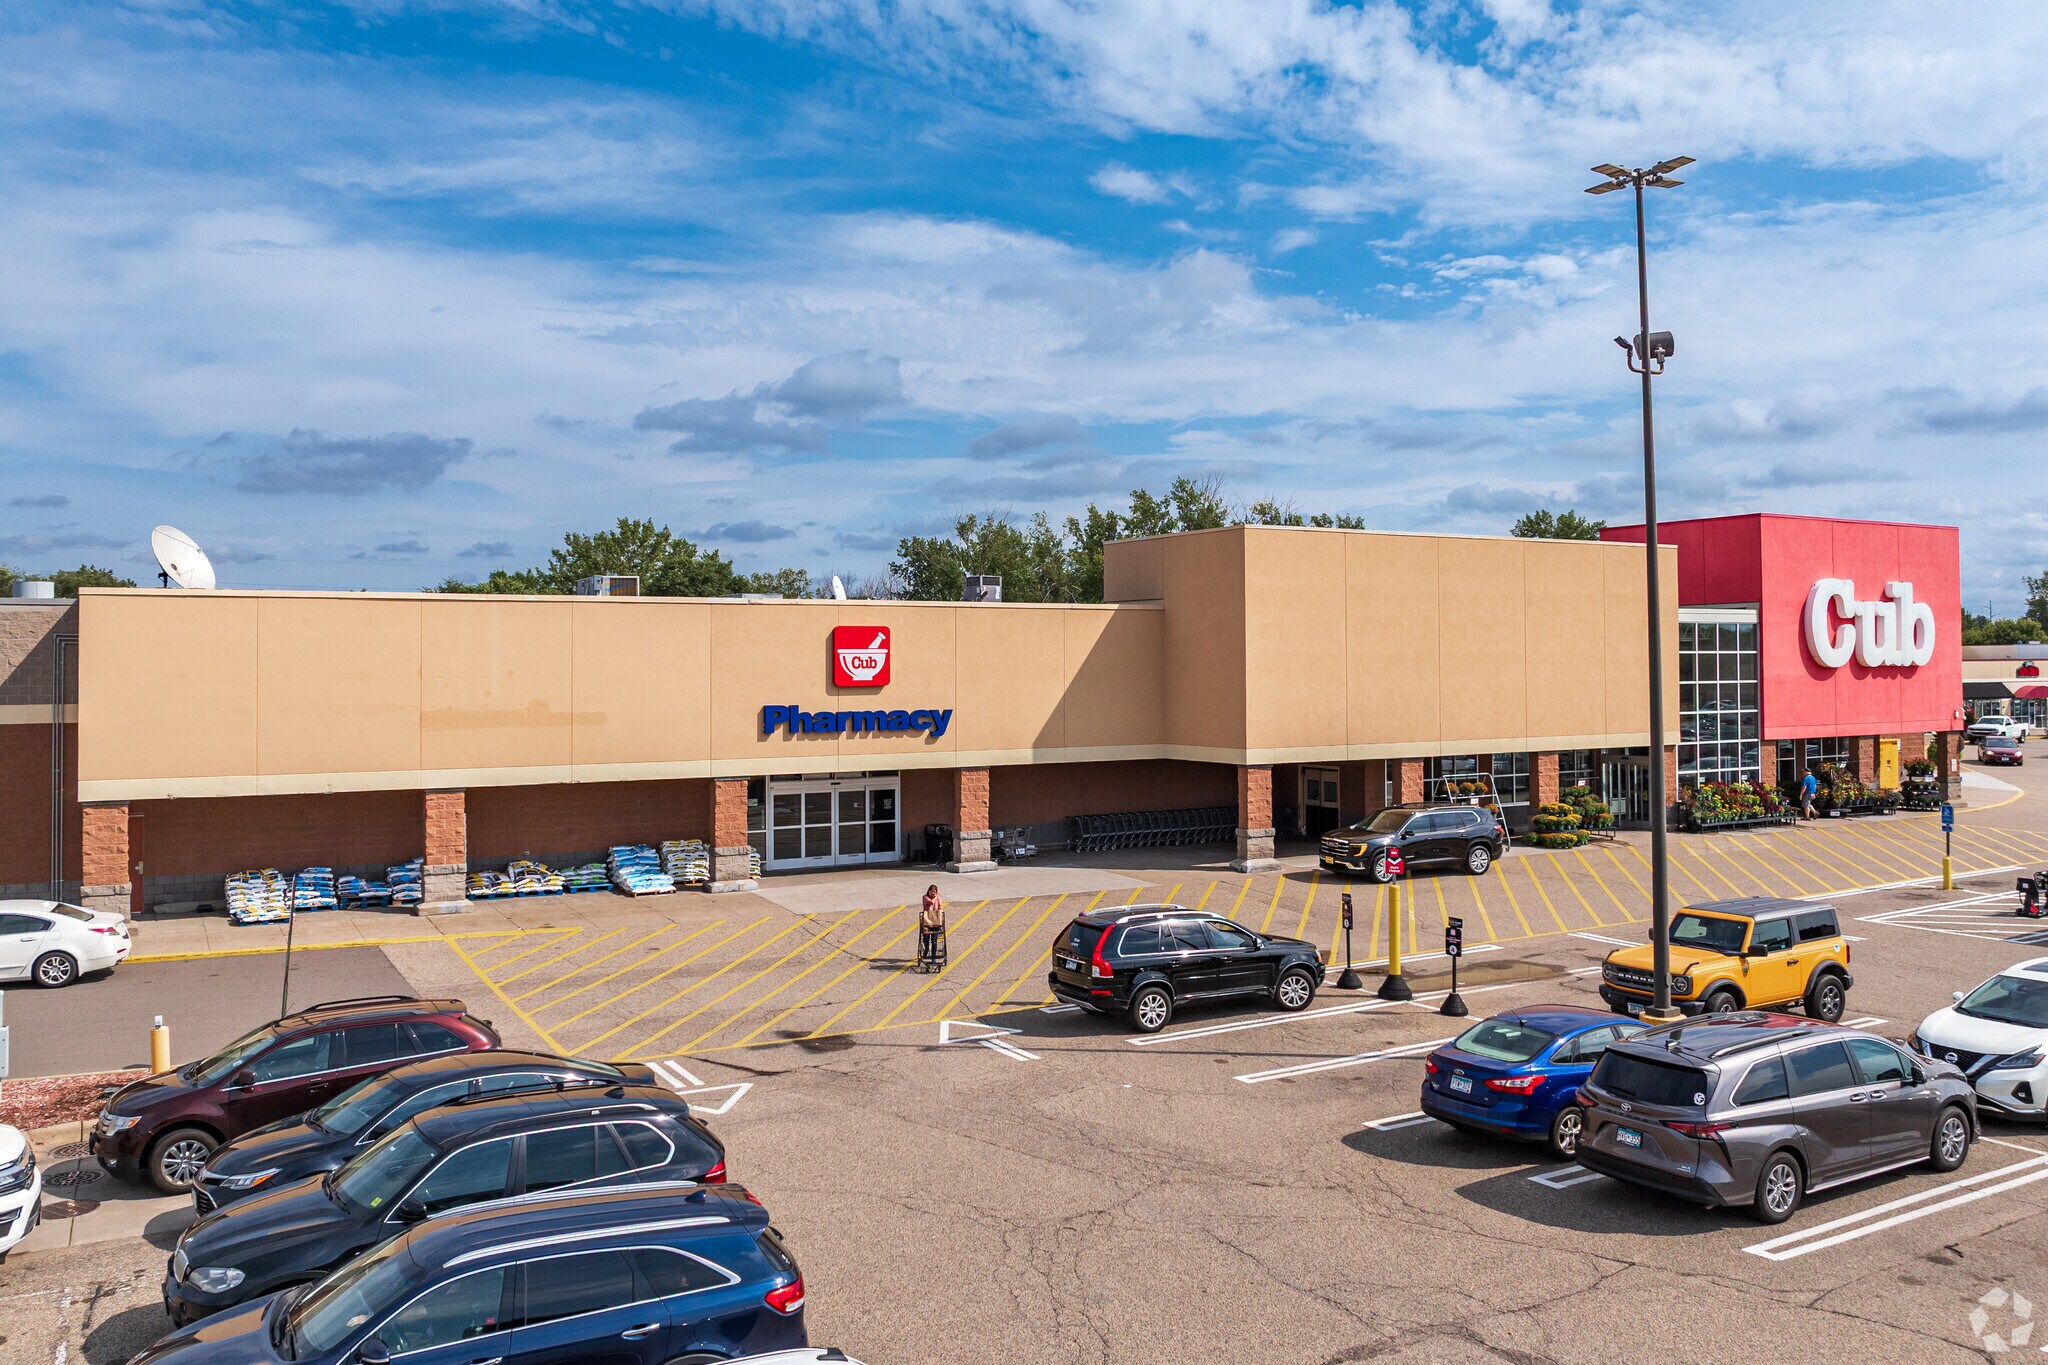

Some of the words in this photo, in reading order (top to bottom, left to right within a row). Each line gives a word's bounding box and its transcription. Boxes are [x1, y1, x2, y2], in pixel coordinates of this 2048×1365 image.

[1804, 577, 1936, 668] Cub
[851, 656, 878, 670] Cub
[763, 704, 953, 737] Pharmacy
[1618, 973, 1654, 983] BRONC
